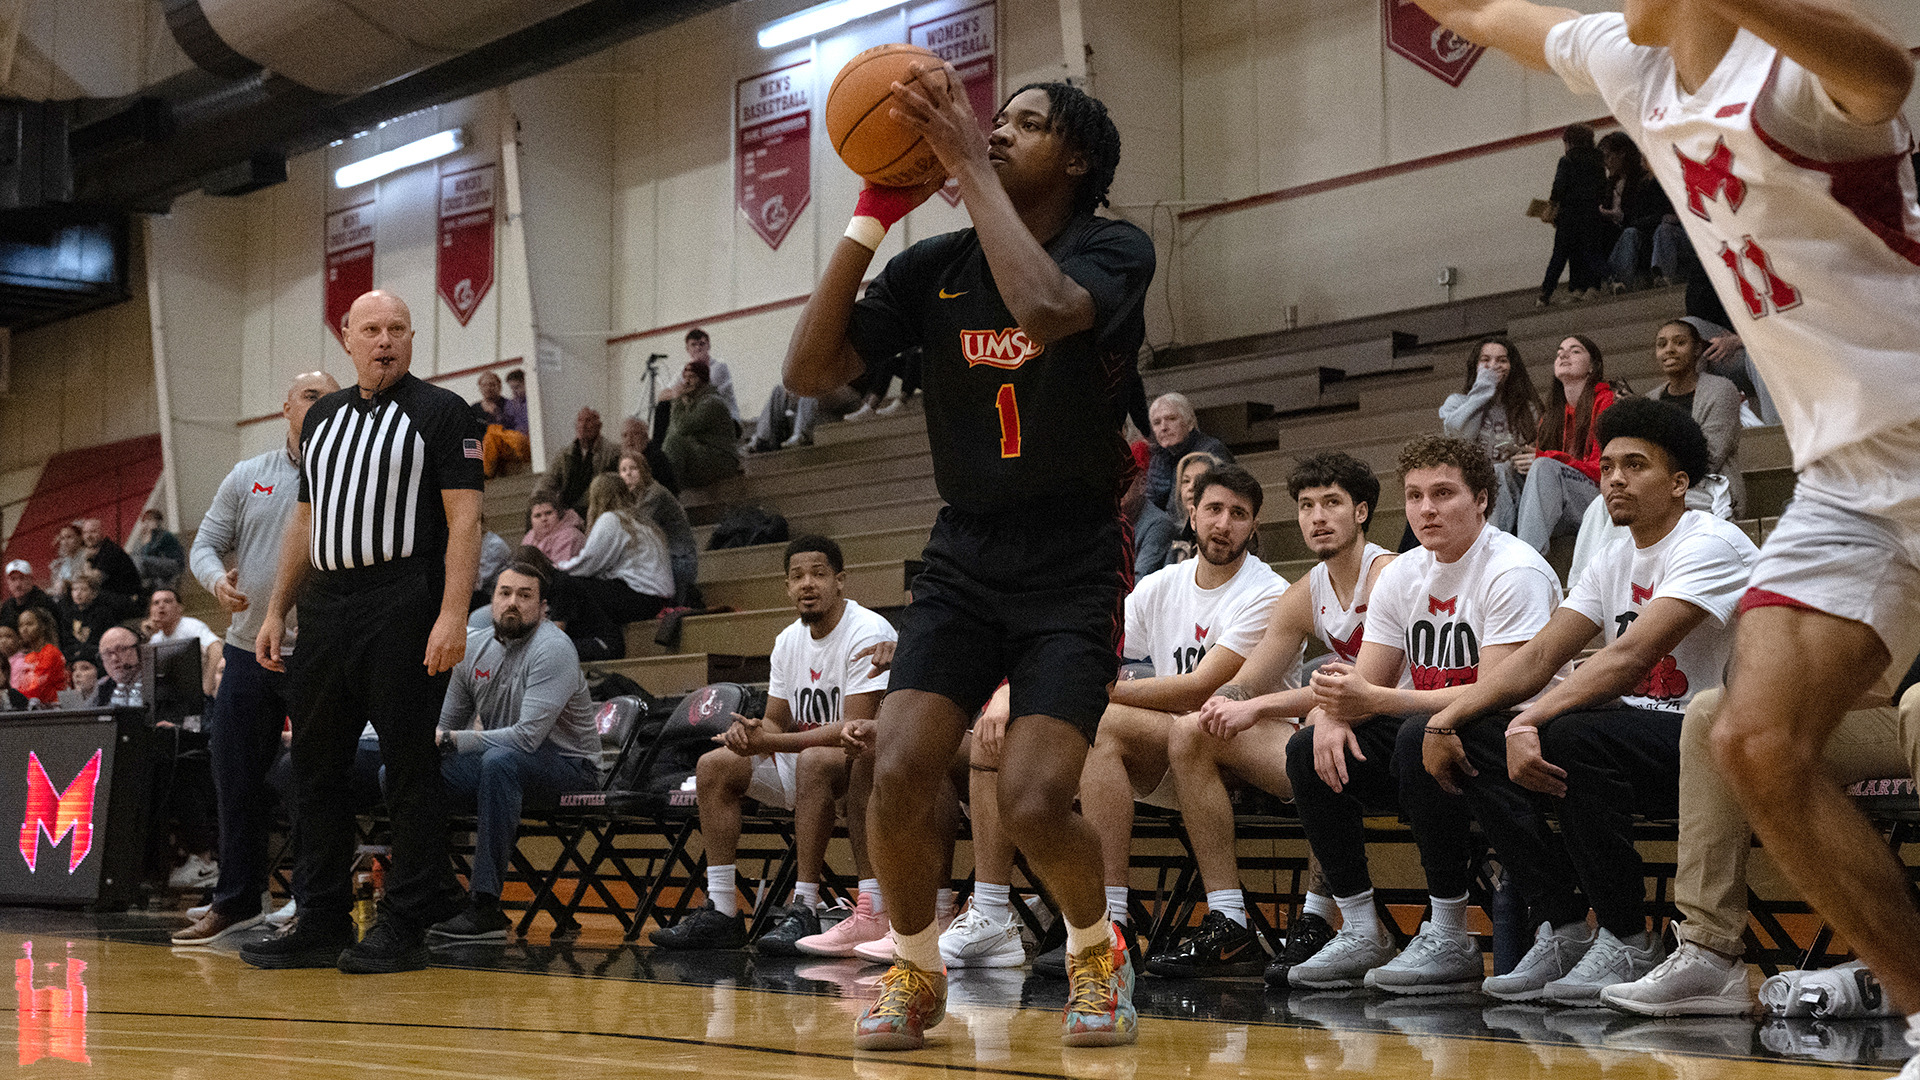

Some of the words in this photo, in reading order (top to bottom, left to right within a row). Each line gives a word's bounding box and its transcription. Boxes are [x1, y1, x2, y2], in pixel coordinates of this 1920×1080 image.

[927, 16, 980, 46] WOMEN'S
[933, 33, 990, 61] KETBALL
[760, 75, 790, 98] MEN'S
[743, 90, 808, 122] BASKETBALL
[1718, 234, 1803, 320] 11
[995, 383, 1021, 459] 1
[18, 748, 102, 876] M
[559, 793, 607, 807] MARYVILLE
